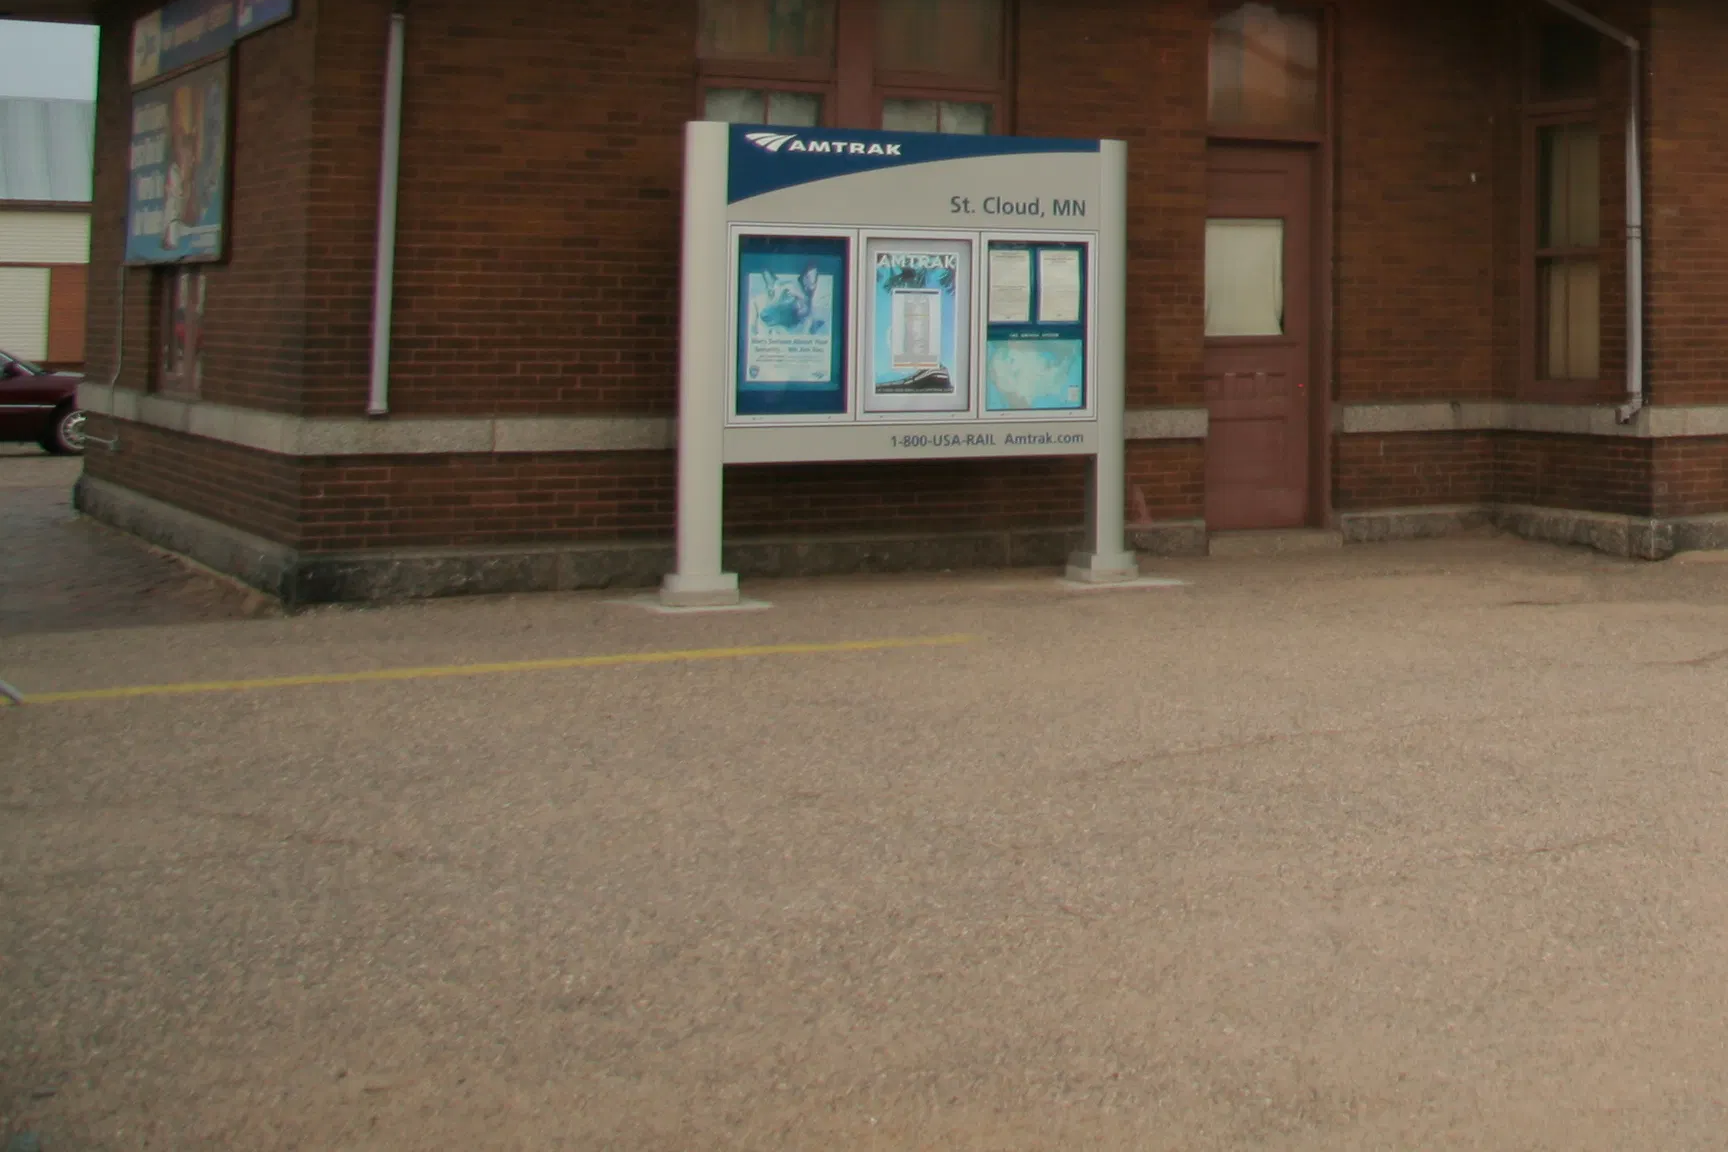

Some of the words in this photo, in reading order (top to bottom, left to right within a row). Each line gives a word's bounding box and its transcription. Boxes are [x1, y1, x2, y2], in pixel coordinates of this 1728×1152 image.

[788, 139, 902, 156] AMTRAK
[950, 195, 976, 214] St.
[983, 195, 1045, 218] Cloud,
[1052, 198, 1086, 217] MN
[878, 253, 957, 269] AMTRAK
[890, 432, 997, 448] 1-800-USA-RAIL
[1004, 431, 1084, 446] Amtrak.com
